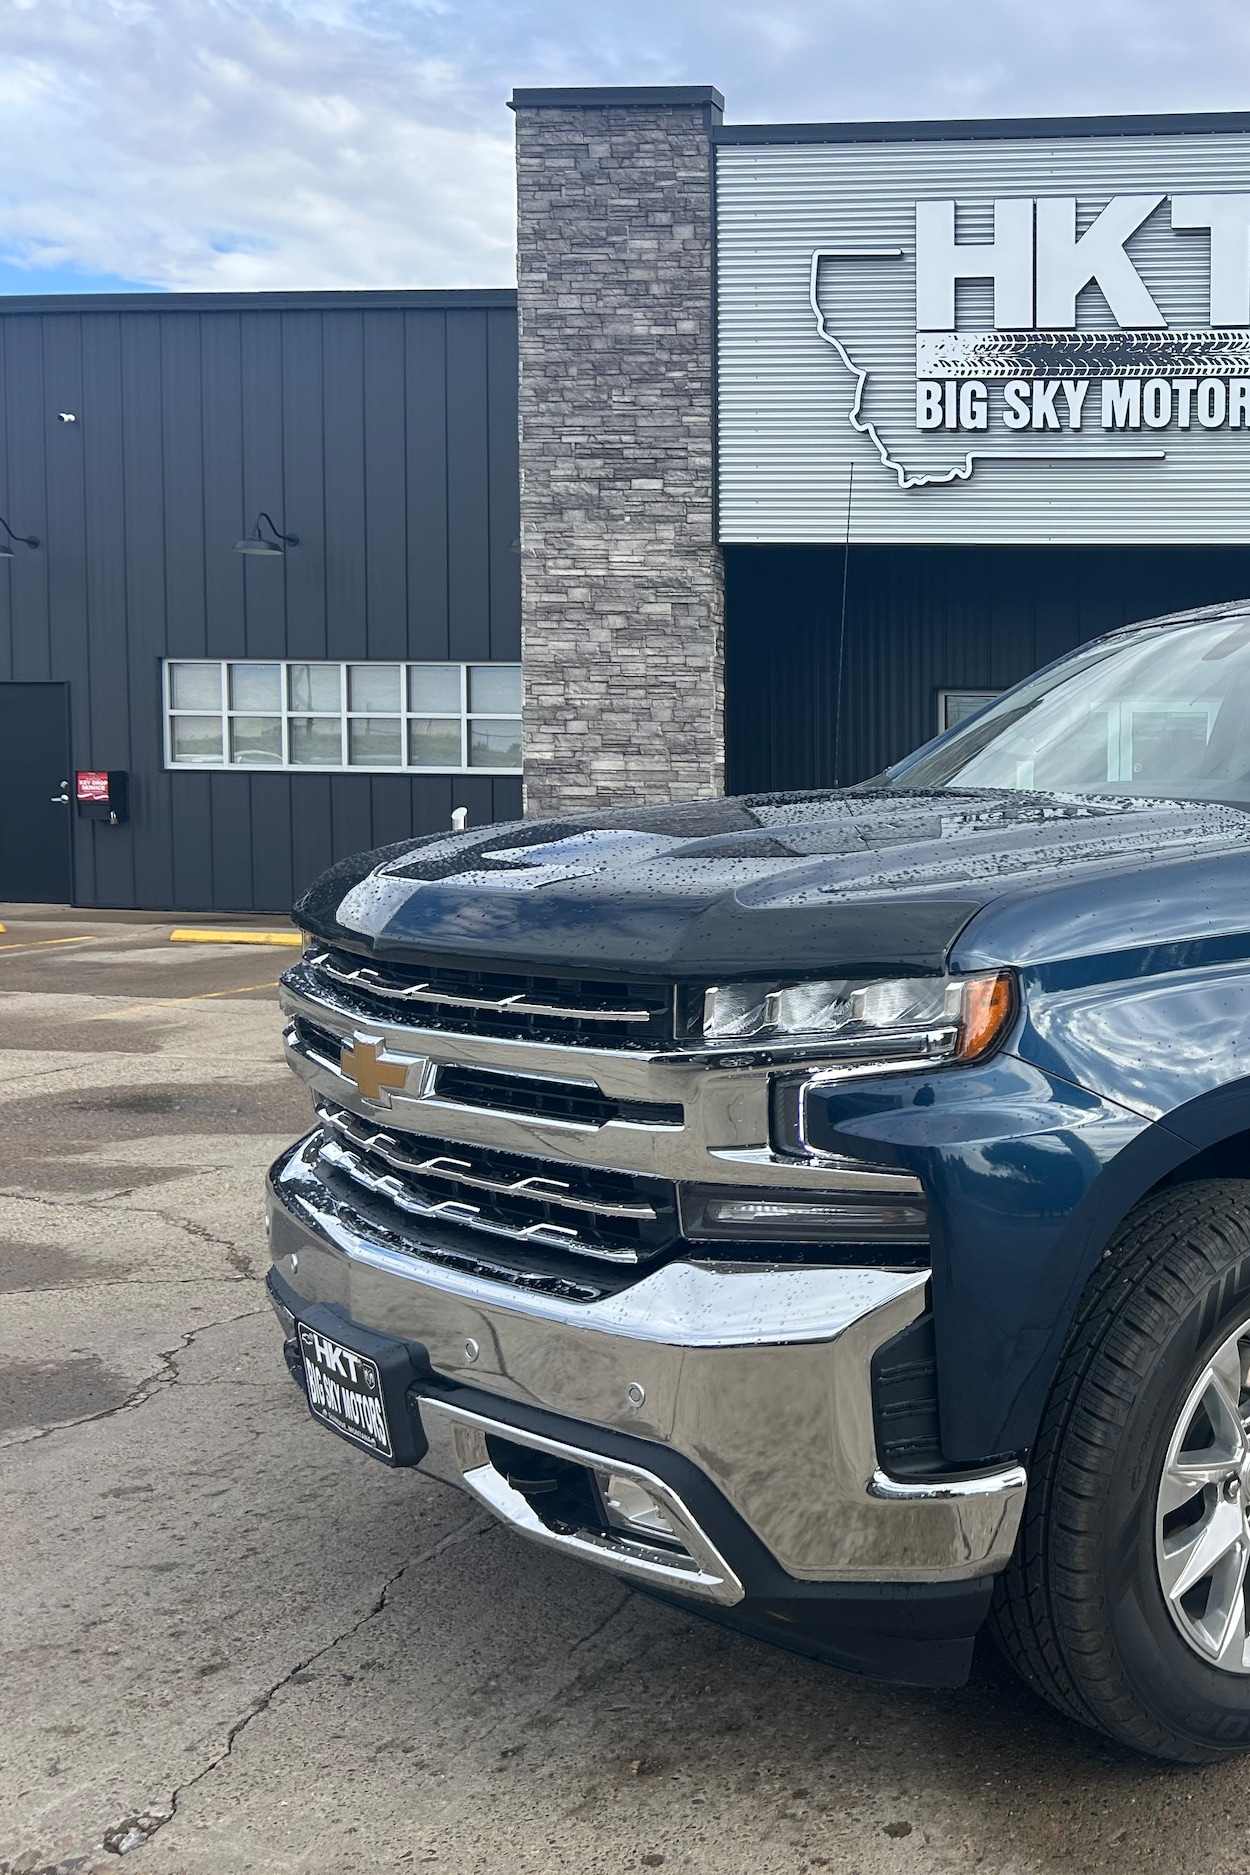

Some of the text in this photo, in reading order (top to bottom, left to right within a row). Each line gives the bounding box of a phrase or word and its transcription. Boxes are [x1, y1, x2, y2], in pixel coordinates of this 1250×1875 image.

[916, 380, 988, 430] BIG
[1003, 379, 1090, 431] SKY
[313, 1333, 358, 1383] HKT
[305, 1357, 387, 1446] BIG SKY MOTORS
